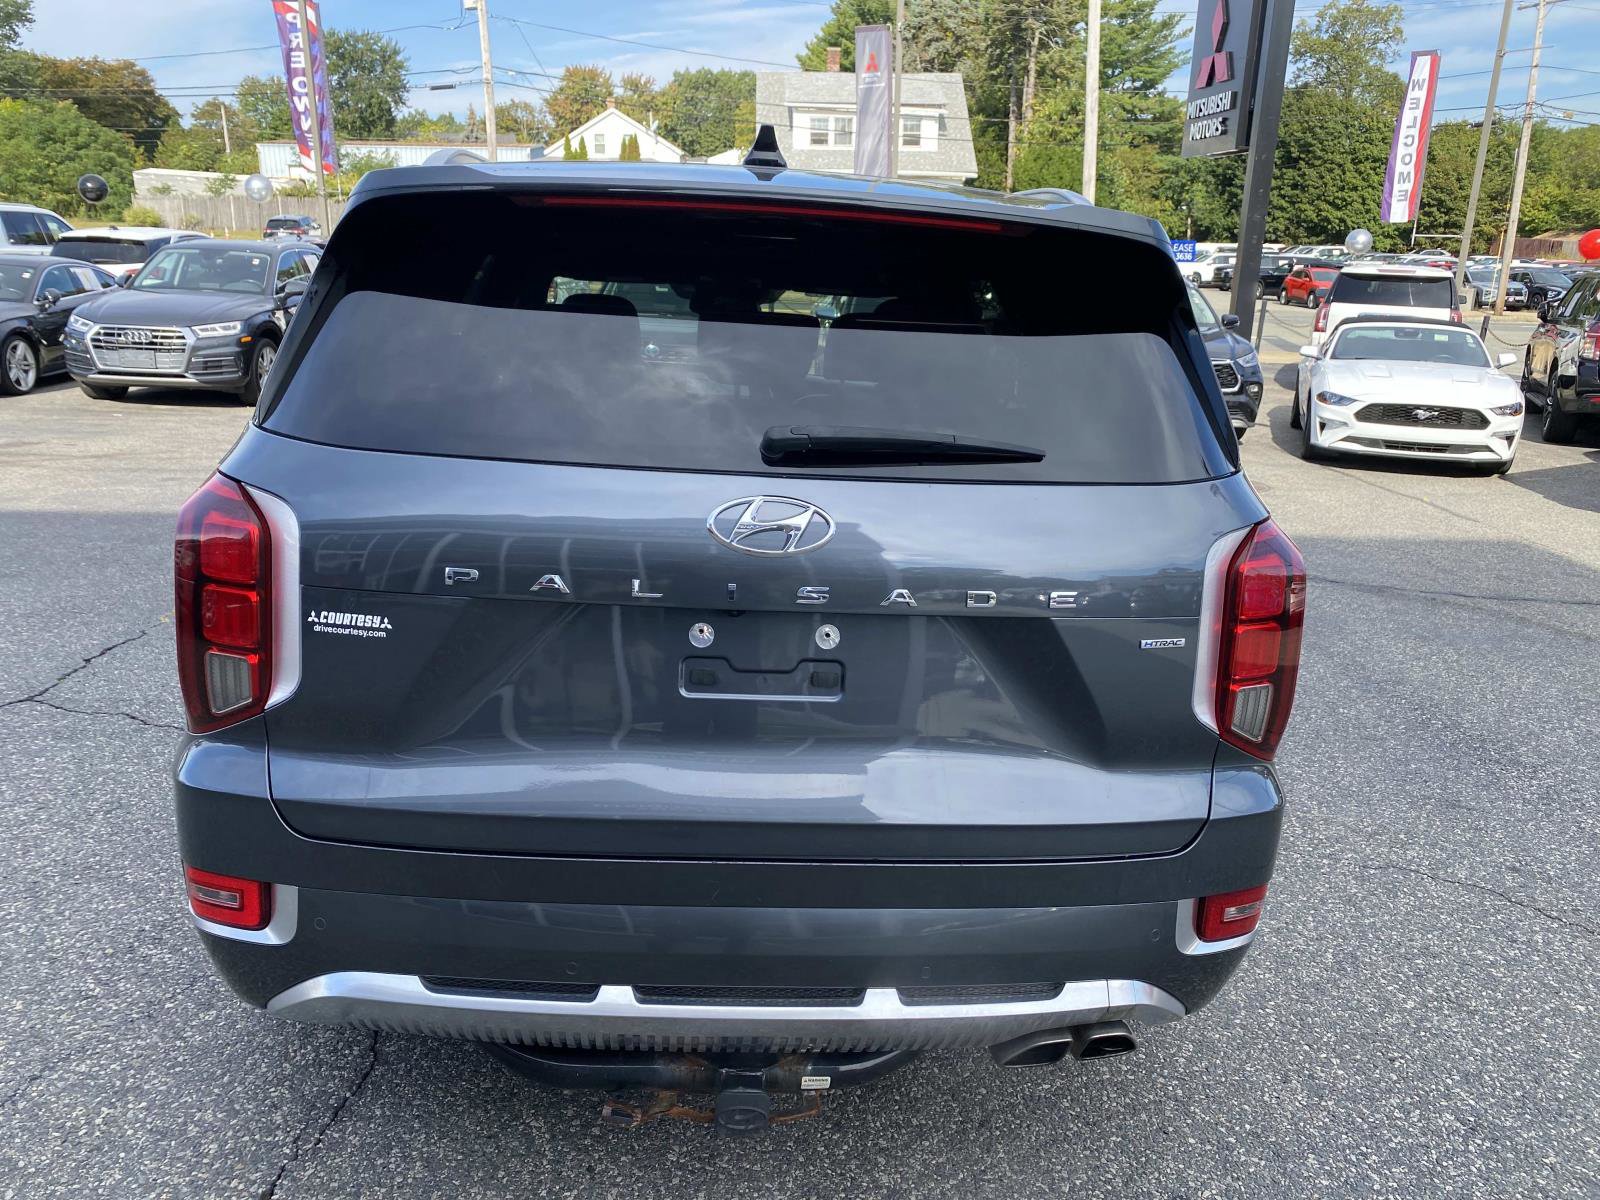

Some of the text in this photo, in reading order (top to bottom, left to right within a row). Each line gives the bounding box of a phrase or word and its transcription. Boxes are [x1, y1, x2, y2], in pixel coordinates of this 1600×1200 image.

[1187, 90, 1232, 120] MITSUBISHI
[1189, 117, 1223, 141] MOTORS
[444, 566, 1078, 609] PALISADE
[320, 611, 381, 628] COURTESY
[313, 624, 386, 638] drivecourtesy.com
[1144, 639, 1183, 648] HTRAC
